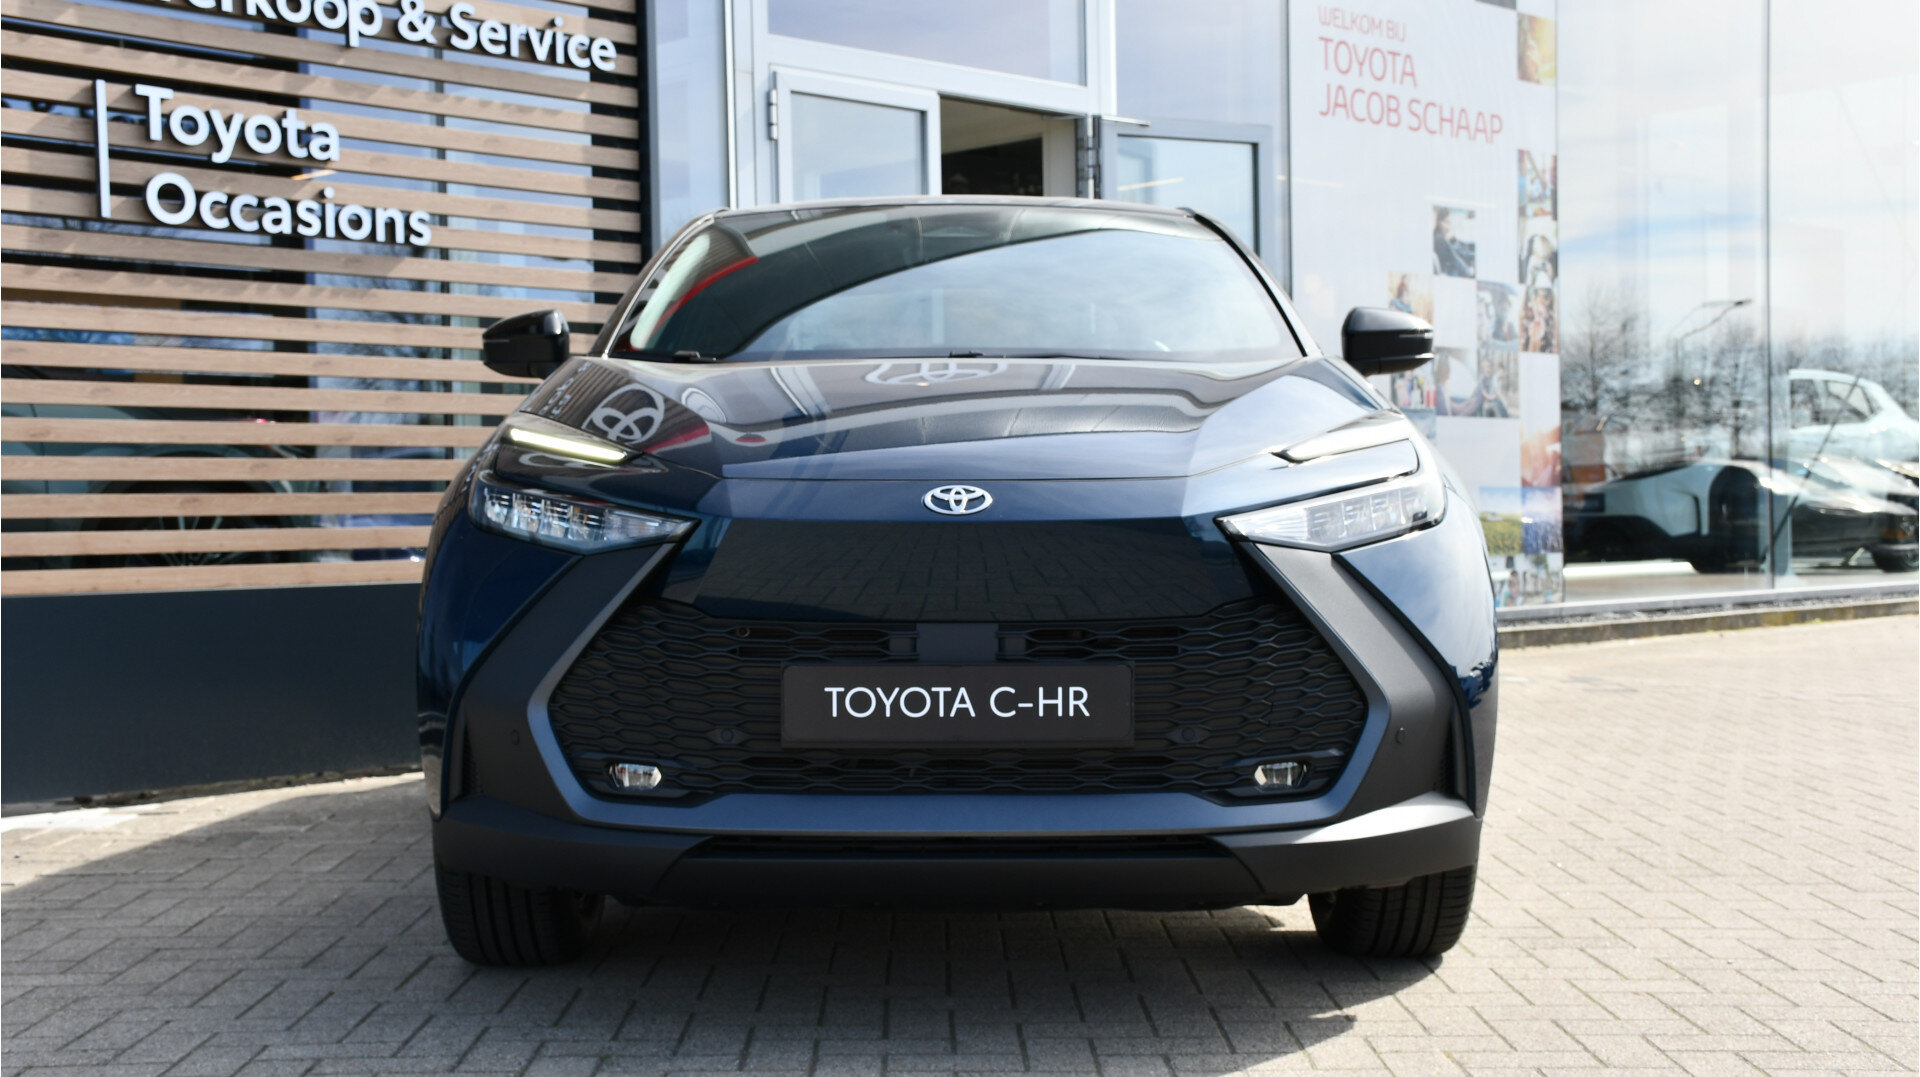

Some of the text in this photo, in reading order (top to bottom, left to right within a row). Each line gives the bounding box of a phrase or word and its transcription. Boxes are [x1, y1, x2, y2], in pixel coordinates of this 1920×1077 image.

[397, 0, 437, 44] &
[450, 3, 617, 72] Service
[1318, 5, 1407, 42] WELKOM BIJ
[1319, 36, 1417, 88] TOYOTA
[135, 84, 341, 163] Toyota
[1319, 83, 1503, 144] JACOB SCHAAP
[146, 172, 431, 246] Occasions
[824, 686, 1091, 718] TOYOTA C-HR
